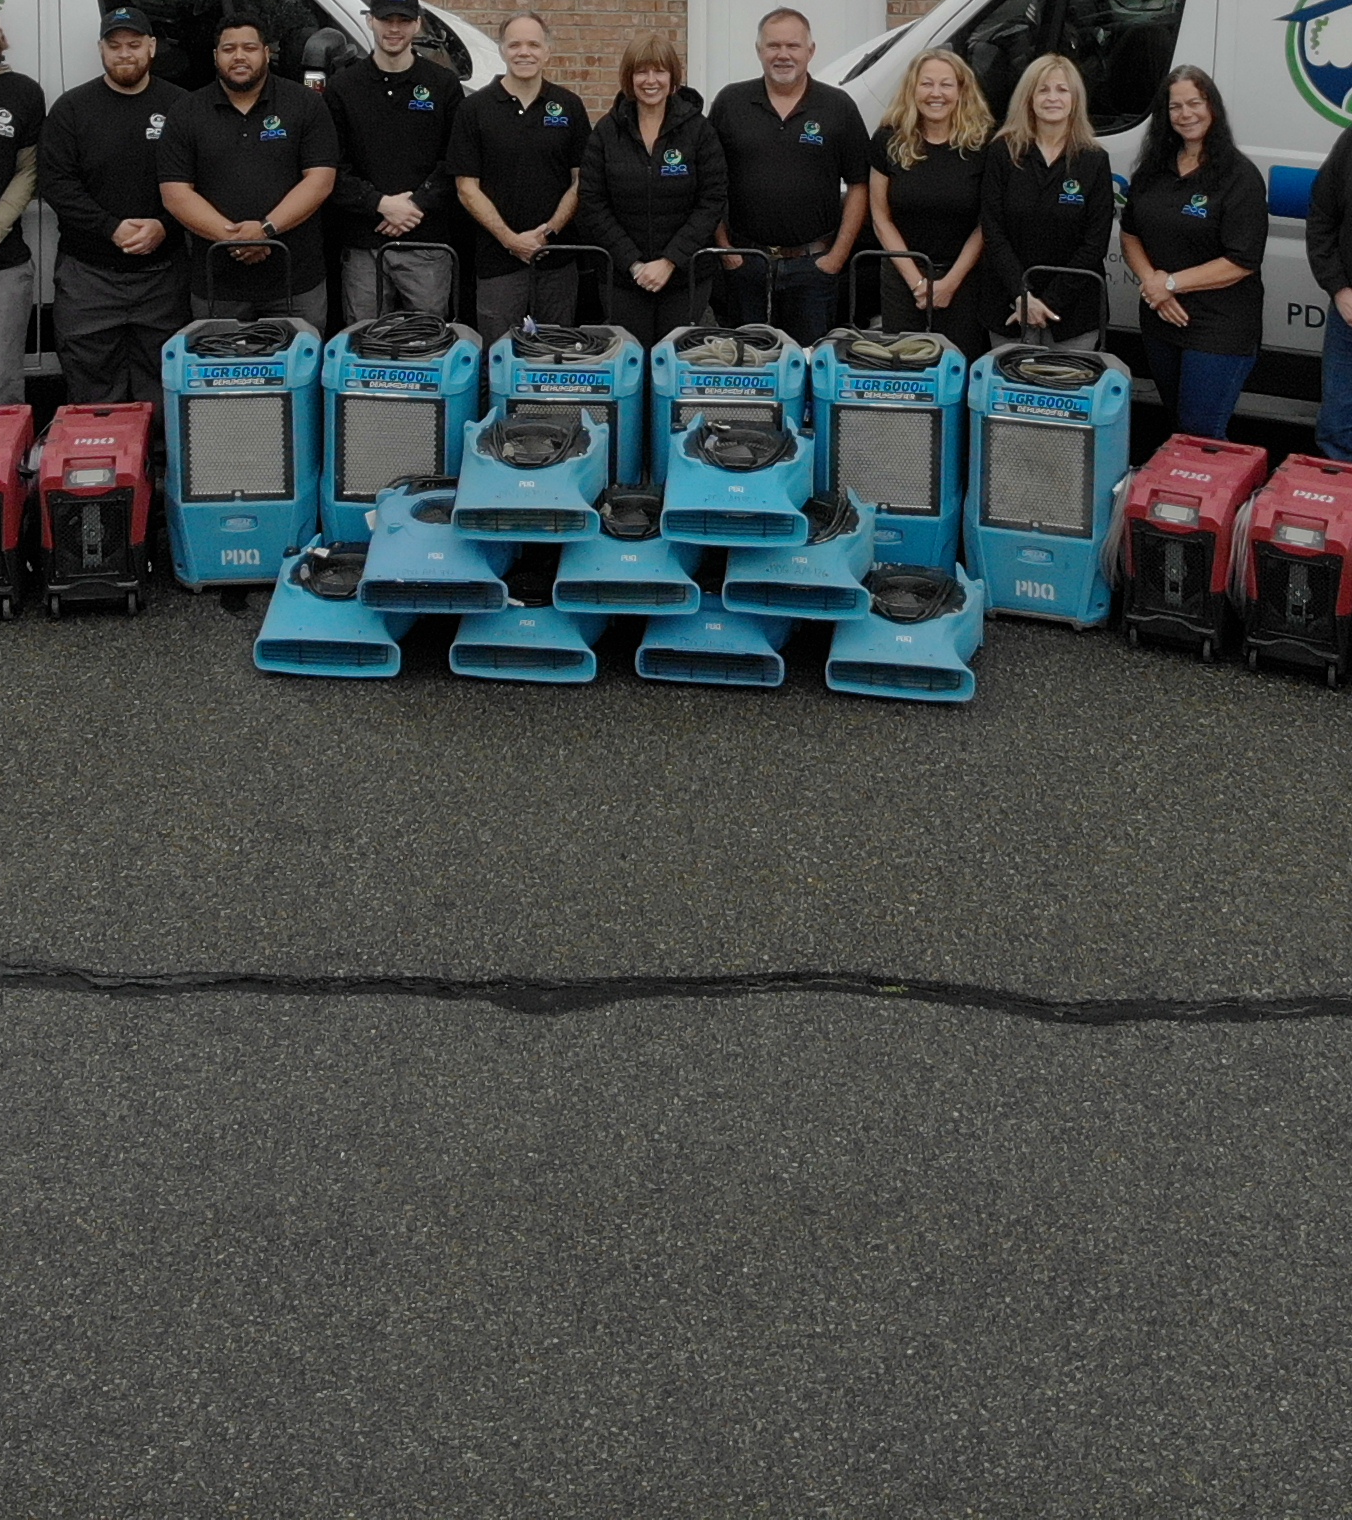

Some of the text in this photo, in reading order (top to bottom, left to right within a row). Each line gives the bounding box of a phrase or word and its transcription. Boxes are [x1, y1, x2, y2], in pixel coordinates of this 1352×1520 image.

[260, 129, 287, 138] PDQ
[661, 164, 688, 173] PDQ
[203, 367, 229, 379] LGR
[360, 368, 387, 380] LGR
[530, 372, 557, 385] LGR
[694, 375, 721, 387] LGR
[854, 379, 881, 391] LGR
[1008, 392, 1035, 405] LGR
[74, 437, 116, 445] PDQ
[1169, 468, 1212, 482] PDQ
[1292, 489, 1336, 502] PDQ
[221, 548, 262, 566] PDQ
[1015, 579, 1056, 601] PDQ
